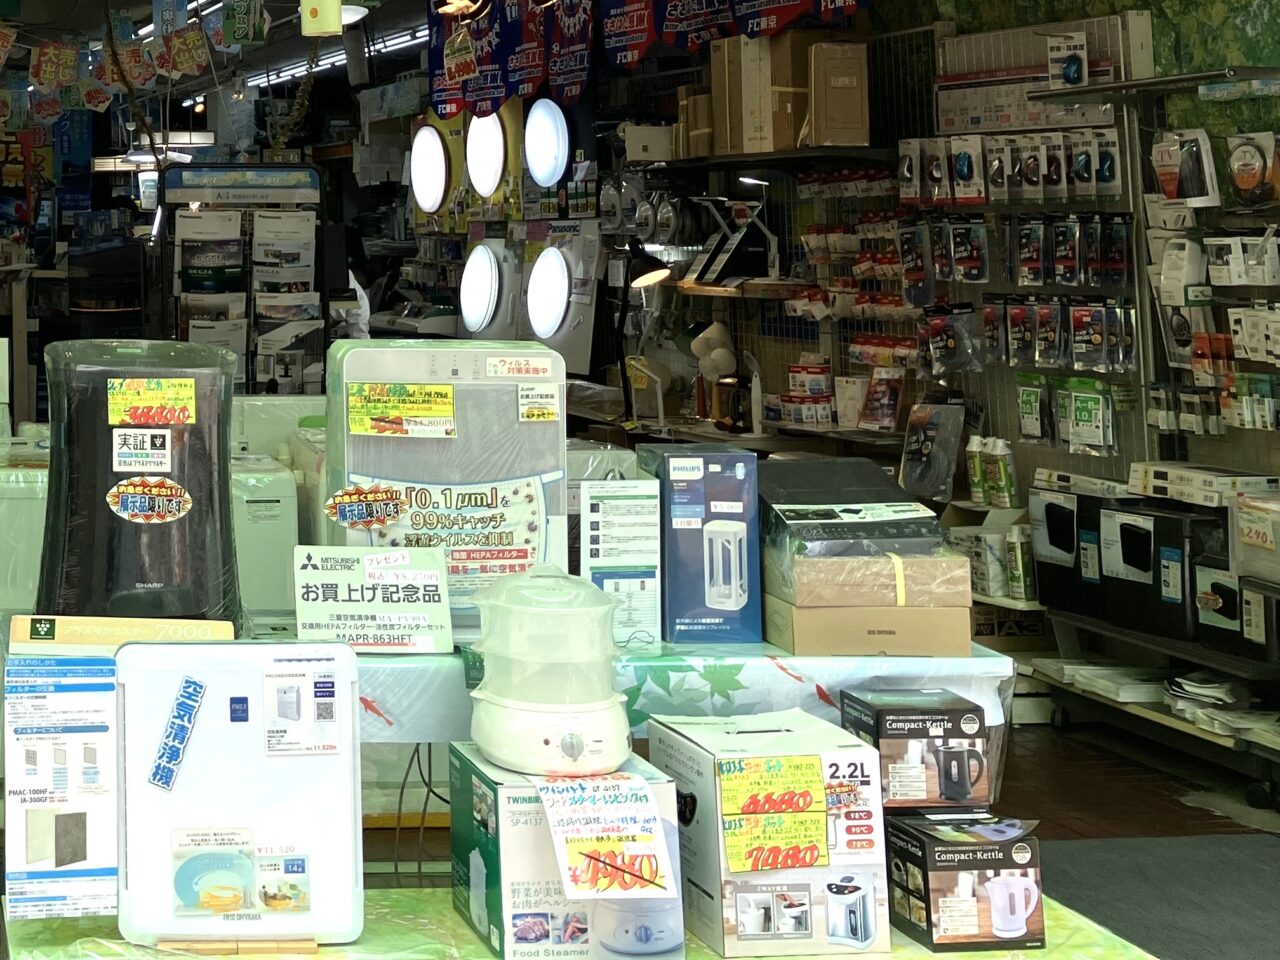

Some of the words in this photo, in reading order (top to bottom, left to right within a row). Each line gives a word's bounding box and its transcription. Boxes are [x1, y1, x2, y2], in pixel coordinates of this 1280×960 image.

[747, 16, 777, 32] FC東京
[1158, 150, 1172, 161] TV
[1242, 151, 1255, 160] TV
[499, 359, 530, 367] ウィルス
[507, 367, 548, 375] 対策実施中
[118, 434, 147, 450] 実証
[119, 495, 183, 514] 展示品限りです
[337, 503, 401, 522] 展示品限りです
[411, 511, 506, 530] 99%キャッチ
[404, 532, 514, 548] 浮遊ウイルスを抑制
[366, 553, 408, 566] プレゼント
[470, 551, 525, 560] HEPAフィルター
[301, 583, 442, 603] お買上げ記念品
[156, 623, 212, 639] 7000
[887, 721, 952, 731] Compact-Kettle
[151, 679, 204, 788] 空気清浄機
[829, 762, 870, 779] 2.2L
[8, 788, 48, 796] PMAC-100HF
[511, 818, 543, 826] SP-4137
[935, 851, 1004, 862] Compact-Kettle
[513, 949, 539, 958] Food
[544, 949, 589, 958] Steamer
